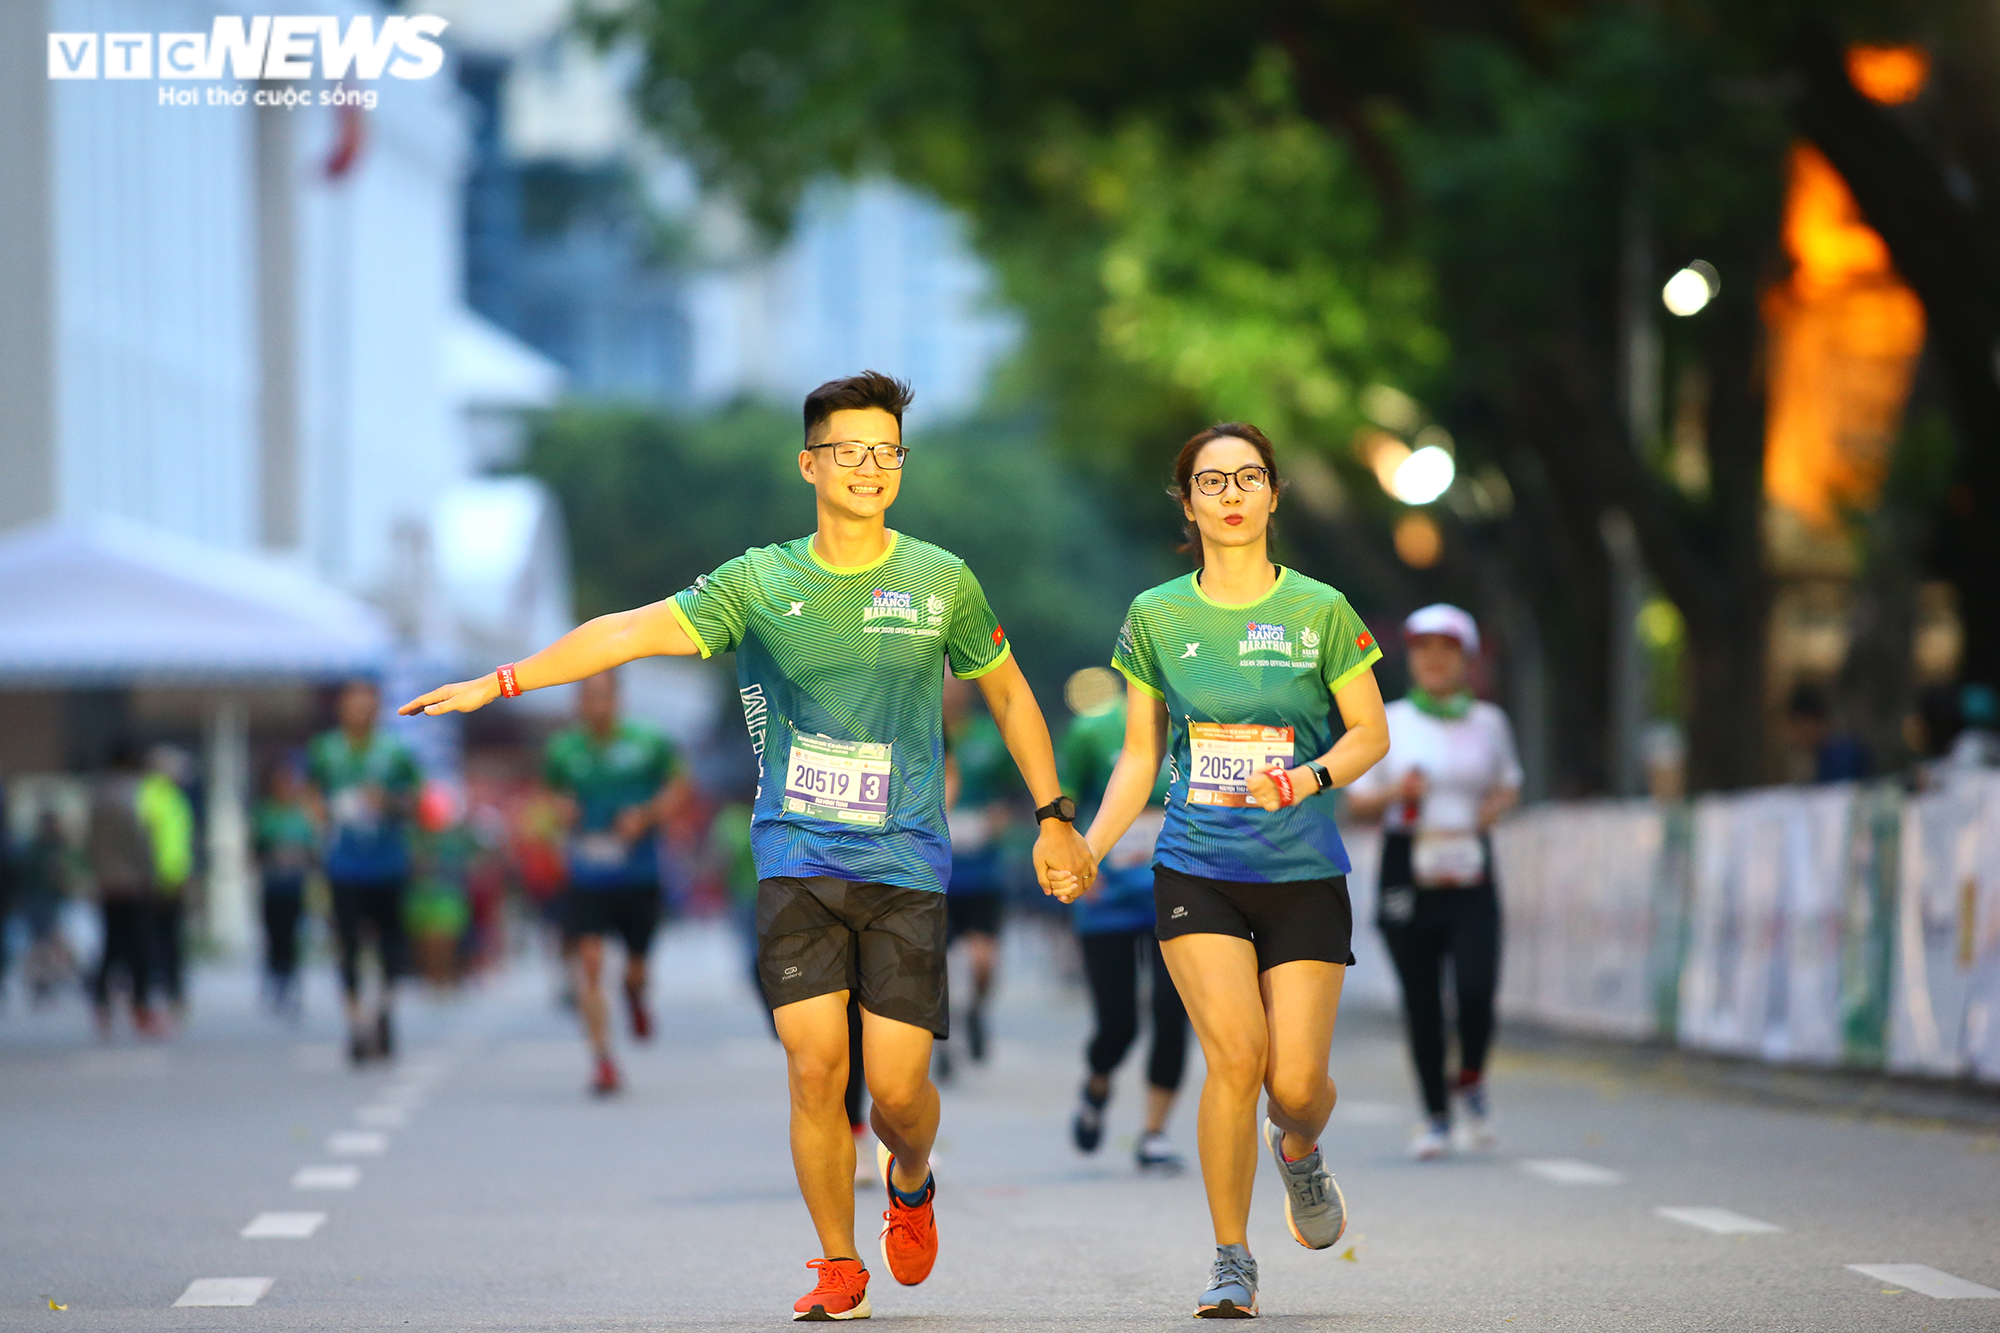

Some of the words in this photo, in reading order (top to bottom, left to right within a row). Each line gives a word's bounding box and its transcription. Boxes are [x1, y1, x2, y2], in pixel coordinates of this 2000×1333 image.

[873, 598, 911, 608] HANOI
[863, 606, 918, 623] MARATHON
[1247, 631, 1285, 641] HANOI
[1239, 640, 1292, 656] MARATHON
[1200, 755, 1253, 780] 20521
[795, 764, 850, 796] 20519
[865, 775, 881, 800] 3
